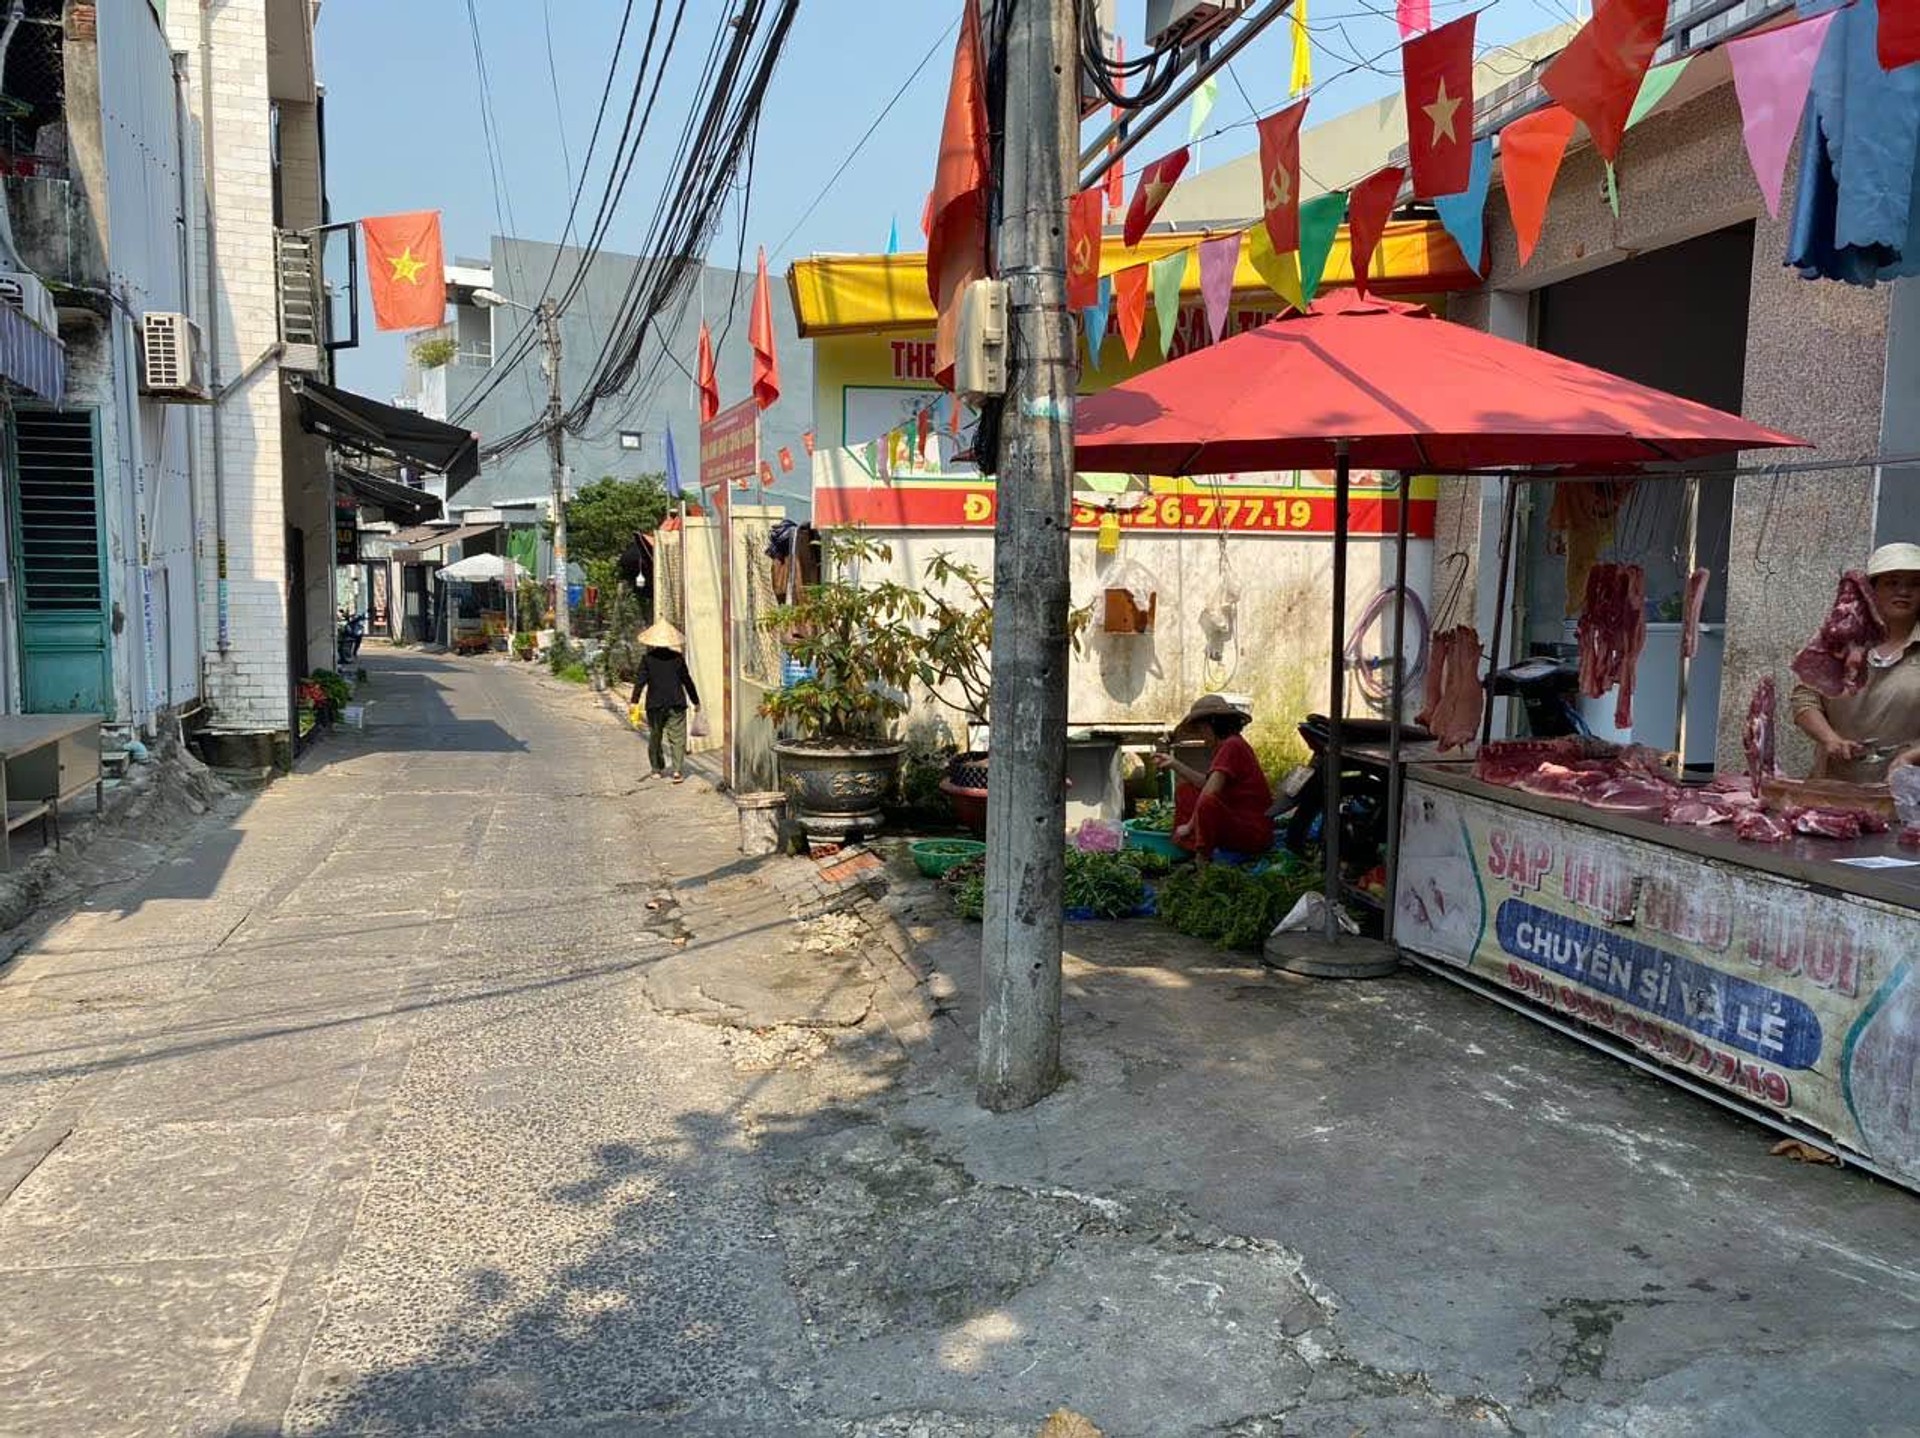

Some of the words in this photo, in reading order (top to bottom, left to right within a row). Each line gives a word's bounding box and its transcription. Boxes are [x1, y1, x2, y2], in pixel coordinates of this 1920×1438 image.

[1487, 827, 1551, 892] SẠP
[1515, 921, 1633, 992] CHUYÊN
[1737, 1002, 1788, 1053] LẺ
